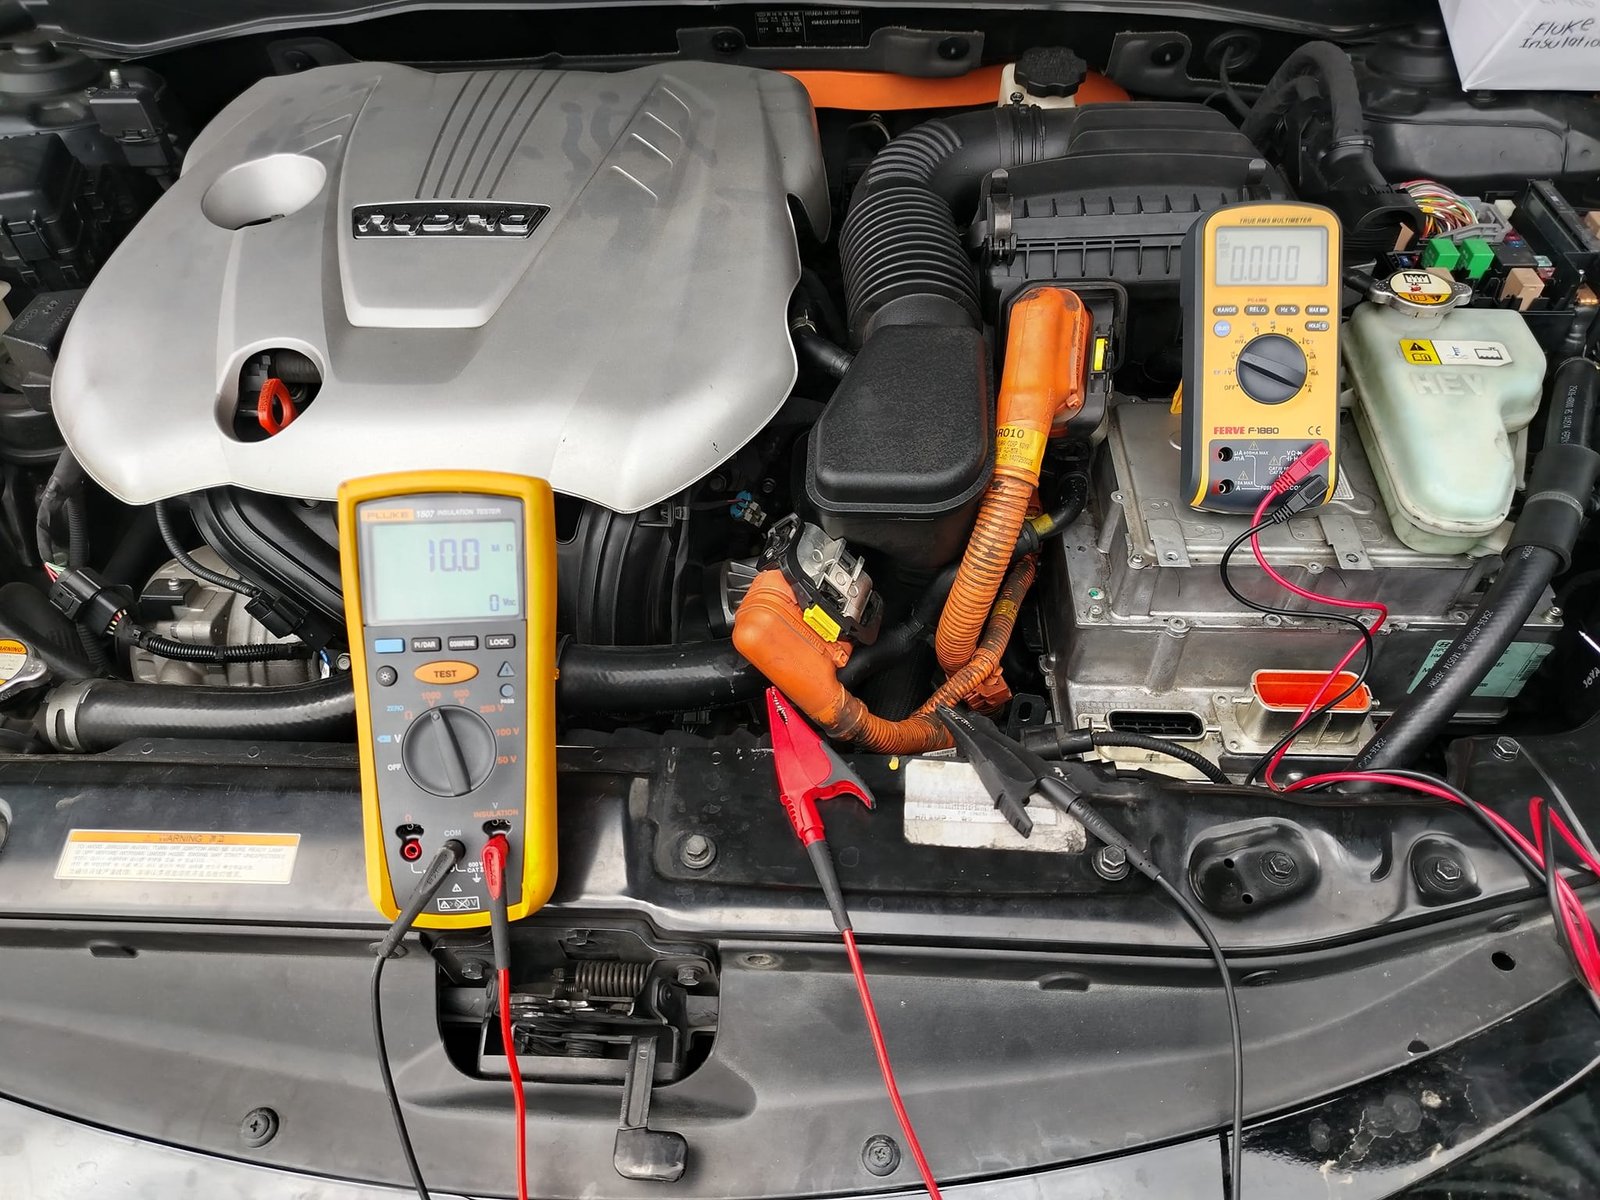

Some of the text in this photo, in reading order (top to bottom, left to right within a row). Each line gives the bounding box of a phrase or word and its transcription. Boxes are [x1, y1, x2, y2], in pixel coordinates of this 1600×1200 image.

[1520, 36, 1600, 49] Insulatio
[1410, 372, 1483, 396] HEV
[1214, 426, 1246, 435] FERVE
[428, 538, 480, 572] 10.0
[473, 809, 519, 818] INSULATION
